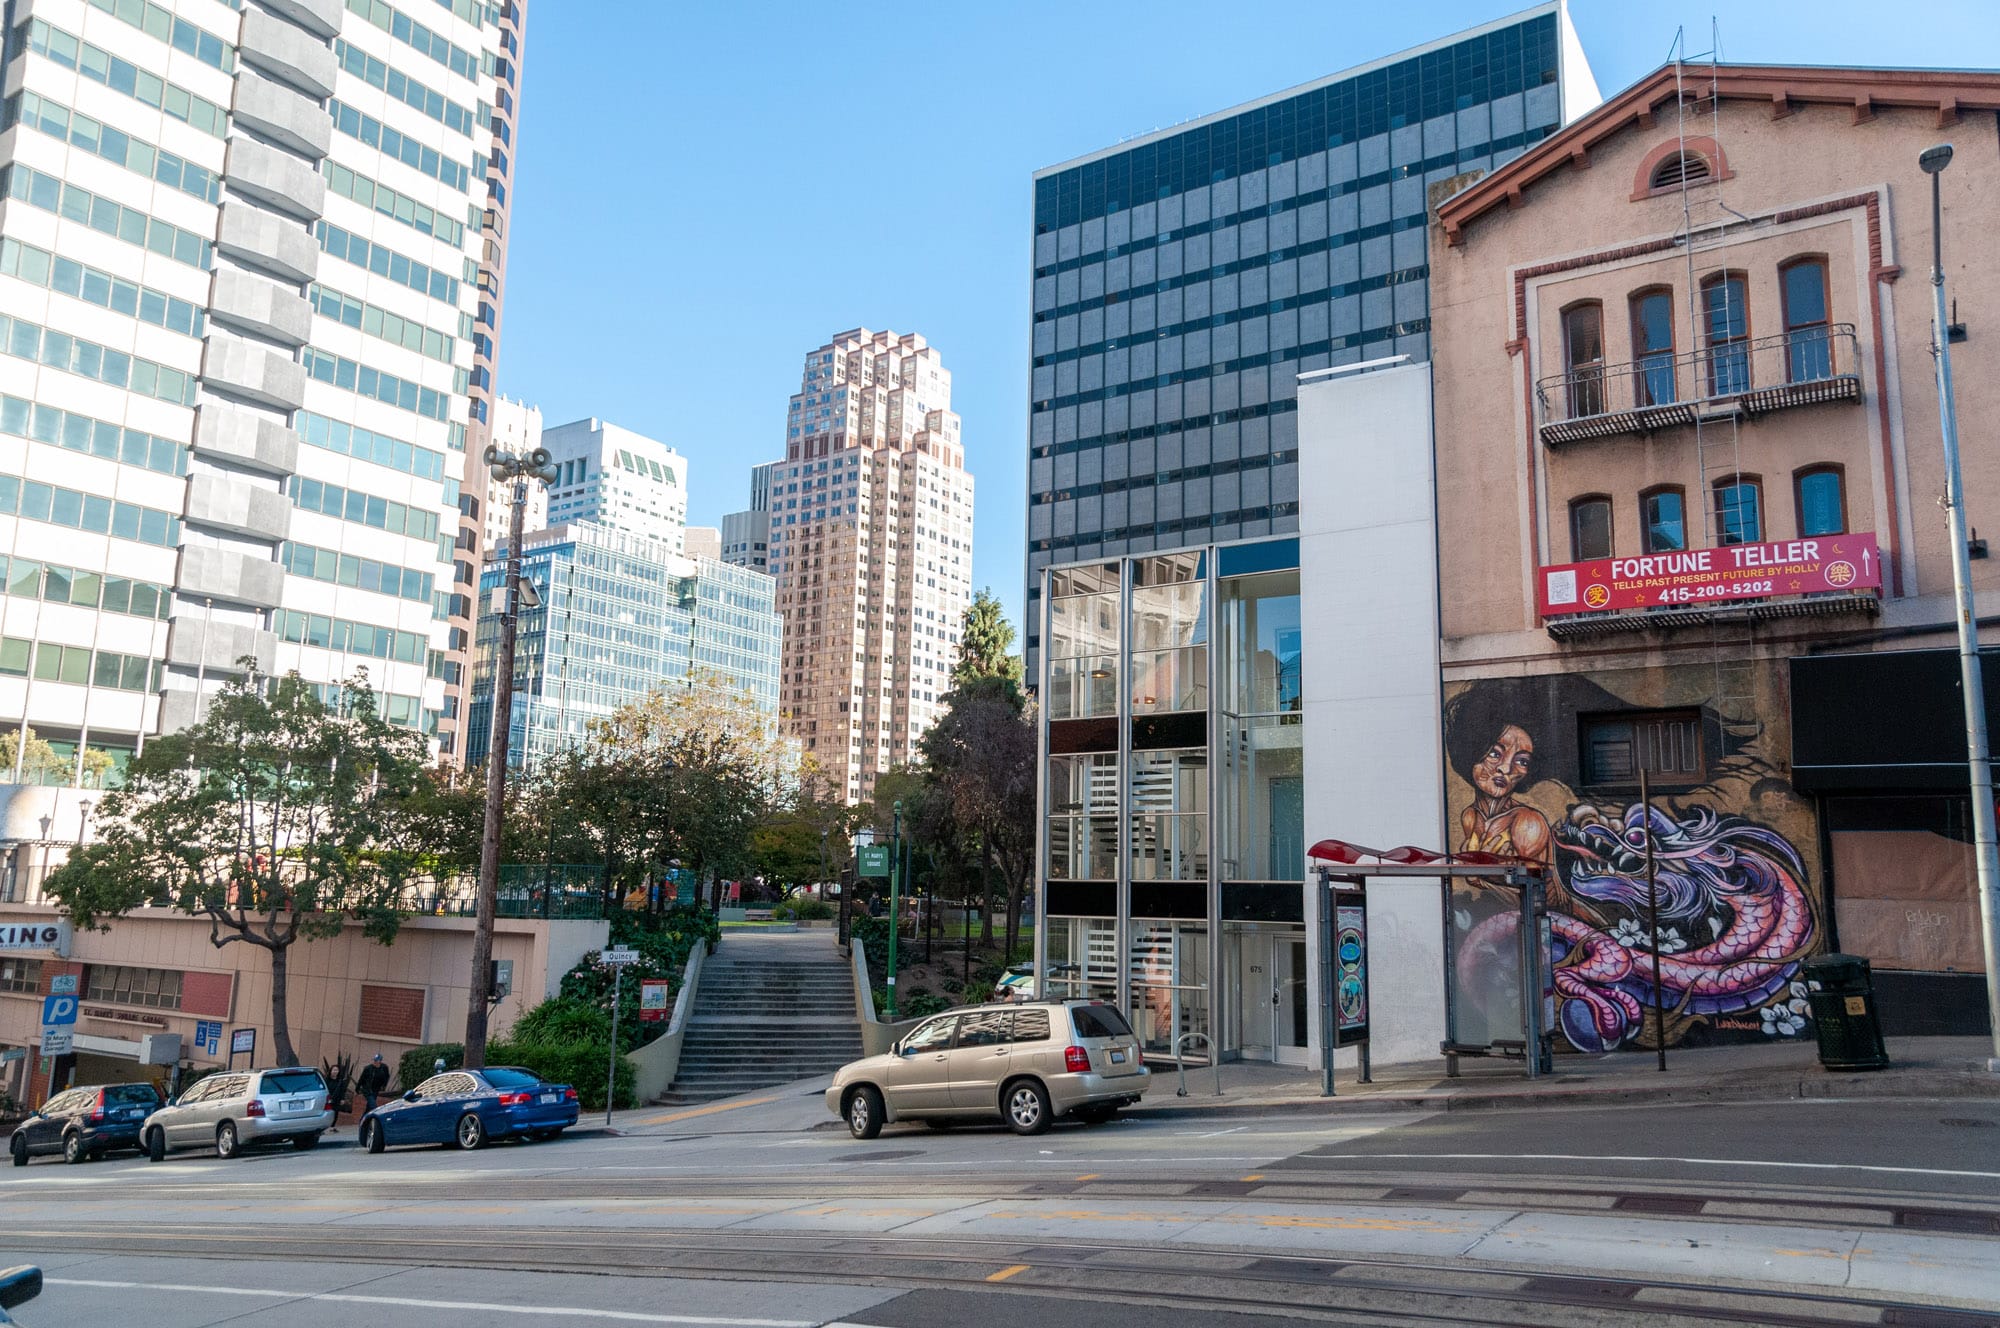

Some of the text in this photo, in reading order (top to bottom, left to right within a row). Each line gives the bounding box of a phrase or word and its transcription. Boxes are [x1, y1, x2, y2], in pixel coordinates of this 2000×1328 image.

[1611, 541, 1820, 579] FORTUNE TELLER
[1613, 562, 1820, 590] TELLS PAST PRESENT FUTURE BY HOLLY
[1588, 586, 1606, 605] 愛
[1658, 580, 1773, 603] 415-200-5202
